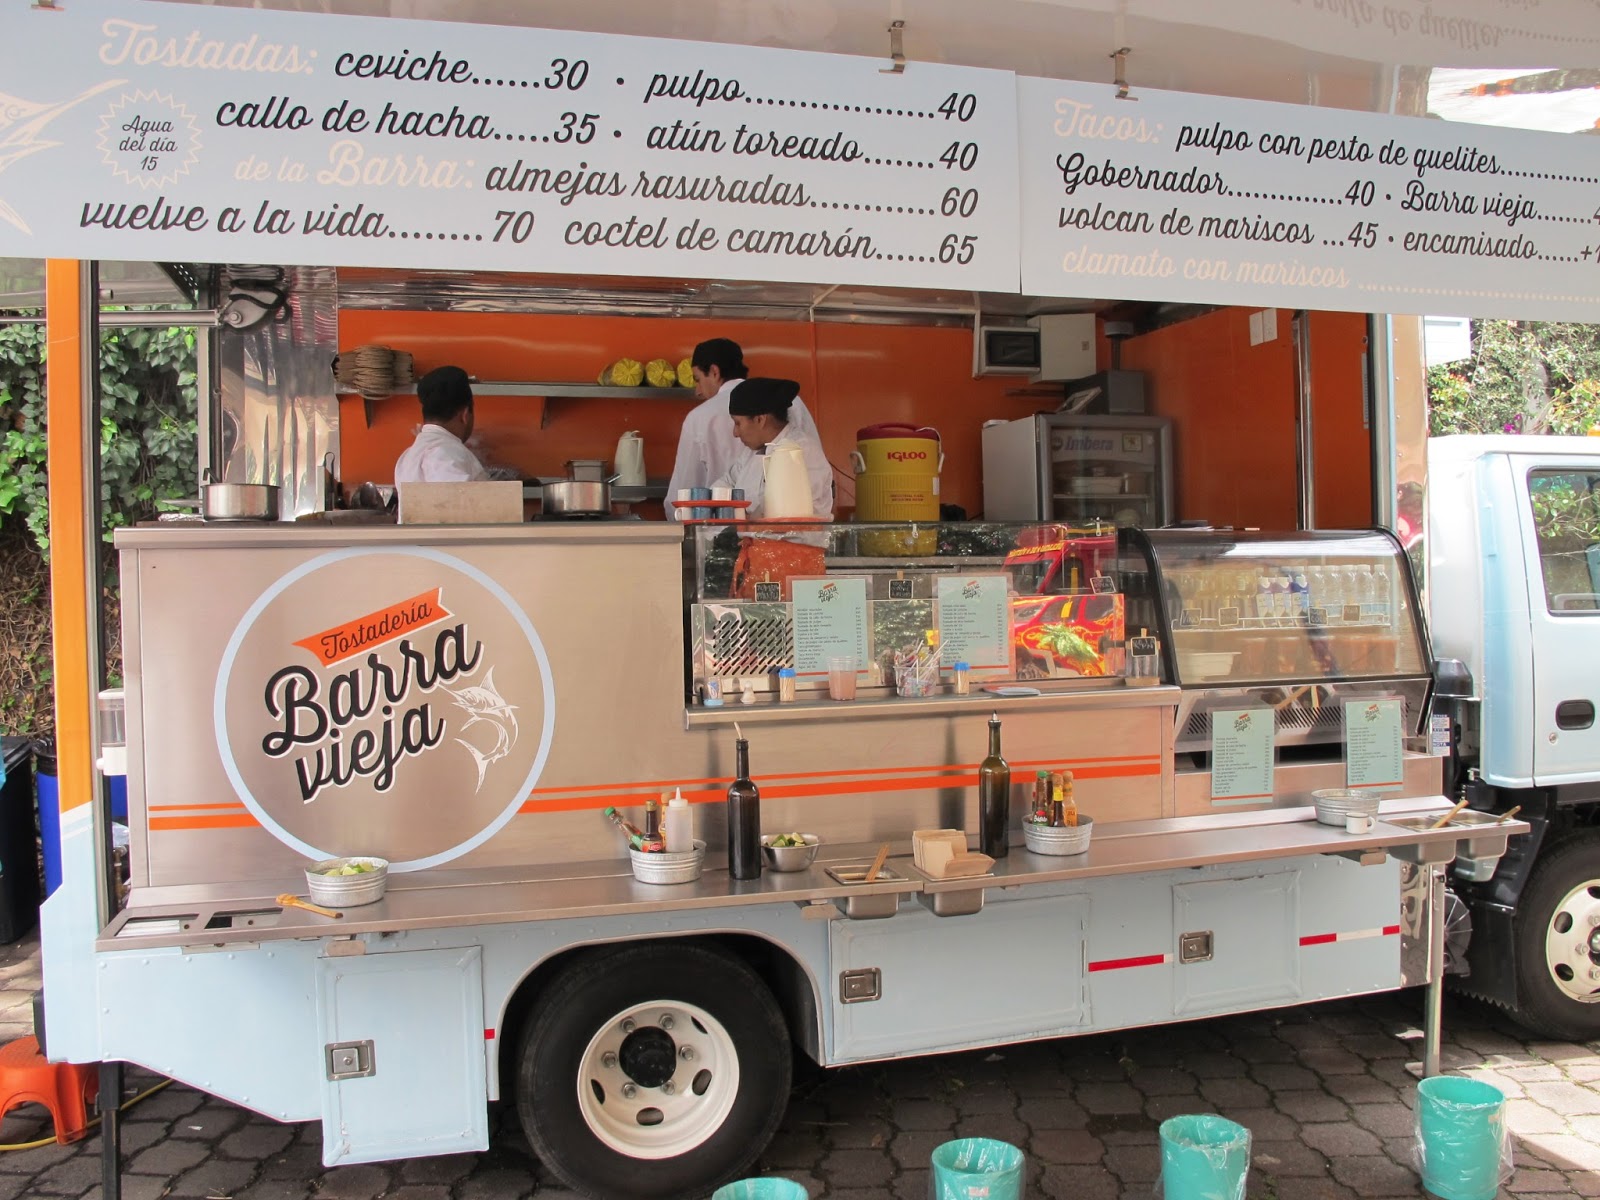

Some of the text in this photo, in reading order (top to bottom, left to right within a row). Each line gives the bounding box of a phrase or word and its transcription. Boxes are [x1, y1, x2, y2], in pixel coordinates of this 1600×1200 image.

[99, 18, 317, 75] Tostadas:
[119, 136, 178, 152] del día
[122, 115, 174, 134] Agua
[216, 96, 313, 130] callo
[322, 100, 370, 133] de
[647, 120, 726, 153] atún
[1054, 98, 1164, 144] Tacos:
[1175, 122, 1253, 155] pulpo
[1259, 134, 1305, 156] con
[1307, 136, 1374, 164] pesto
[1379, 139, 1408, 165] de
[141, 156, 159, 171] 15
[234, 155, 273, 182] de
[277, 156, 307, 183] la
[316, 140, 477, 190] Barra:
[485, 160, 627, 206] almejas
[80, 196, 209, 231] vuelve
[217, 207, 246, 232] a
[253, 200, 295, 234] la
[565, 216, 668, 248] coctel
[676, 219, 719, 251] de
[1059, 203, 1154, 233] volcan
[1160, 208, 1193, 235] de
[1198, 215, 1314, 244] mariscos
[1401, 179, 1478, 214] Barra
[1062, 245, 1351, 289] clamato con mariscos
[886, 451, 927, 462] IGLOO
[321, 600, 432, 660] Tostadería
[262, 623, 484, 757] Barra
[295, 702, 445, 803] vieja
